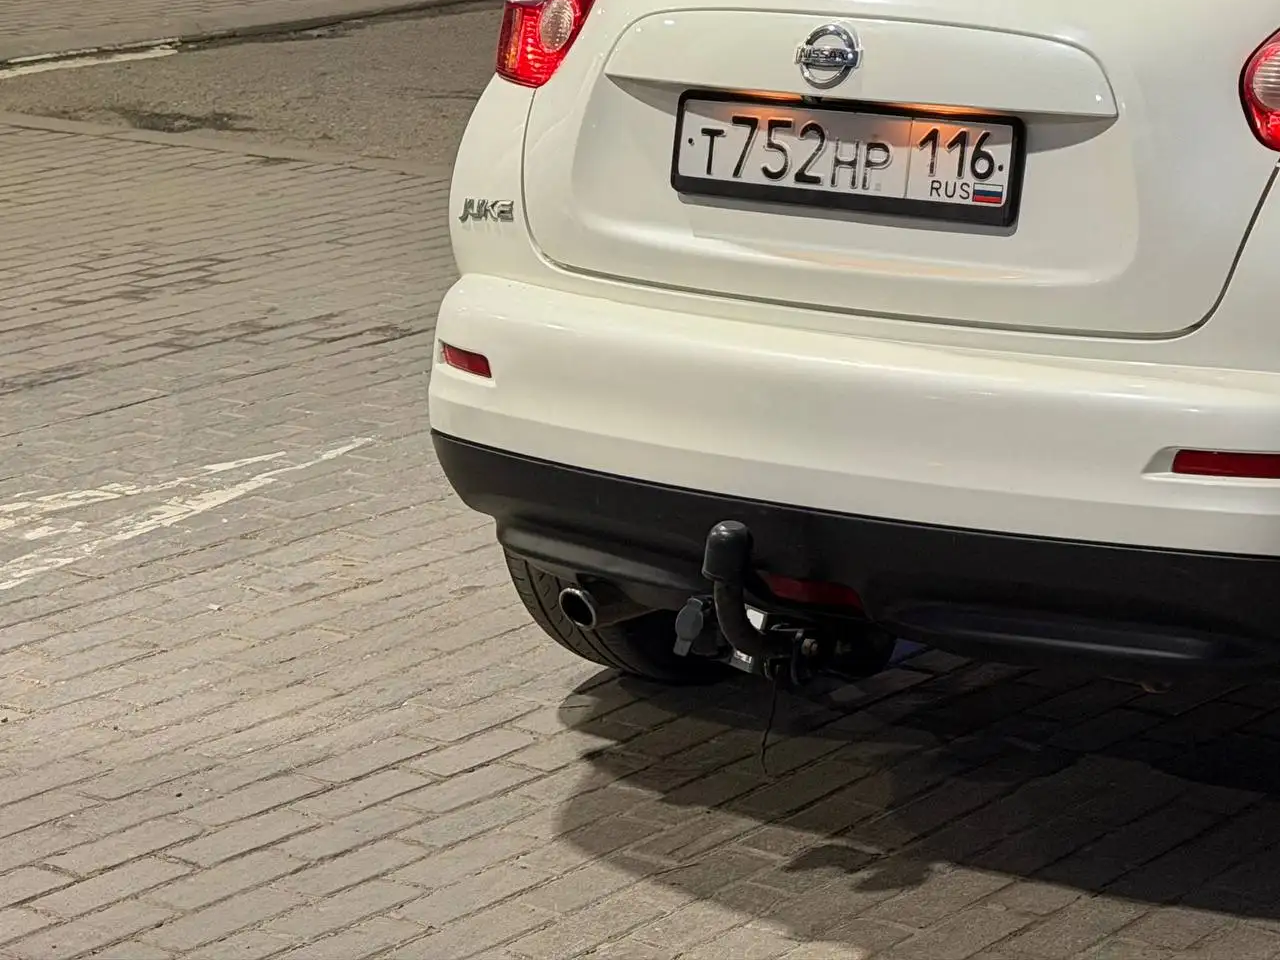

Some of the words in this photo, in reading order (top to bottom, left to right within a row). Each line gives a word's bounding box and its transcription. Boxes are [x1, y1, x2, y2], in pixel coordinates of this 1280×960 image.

[801, 45, 849, 60] NISSAN
[701, 116, 893, 190] Т752НР
[916, 127, 996, 180] 116
[929, 180, 970, 200] RUS
[459, 198, 514, 223] JUKE
